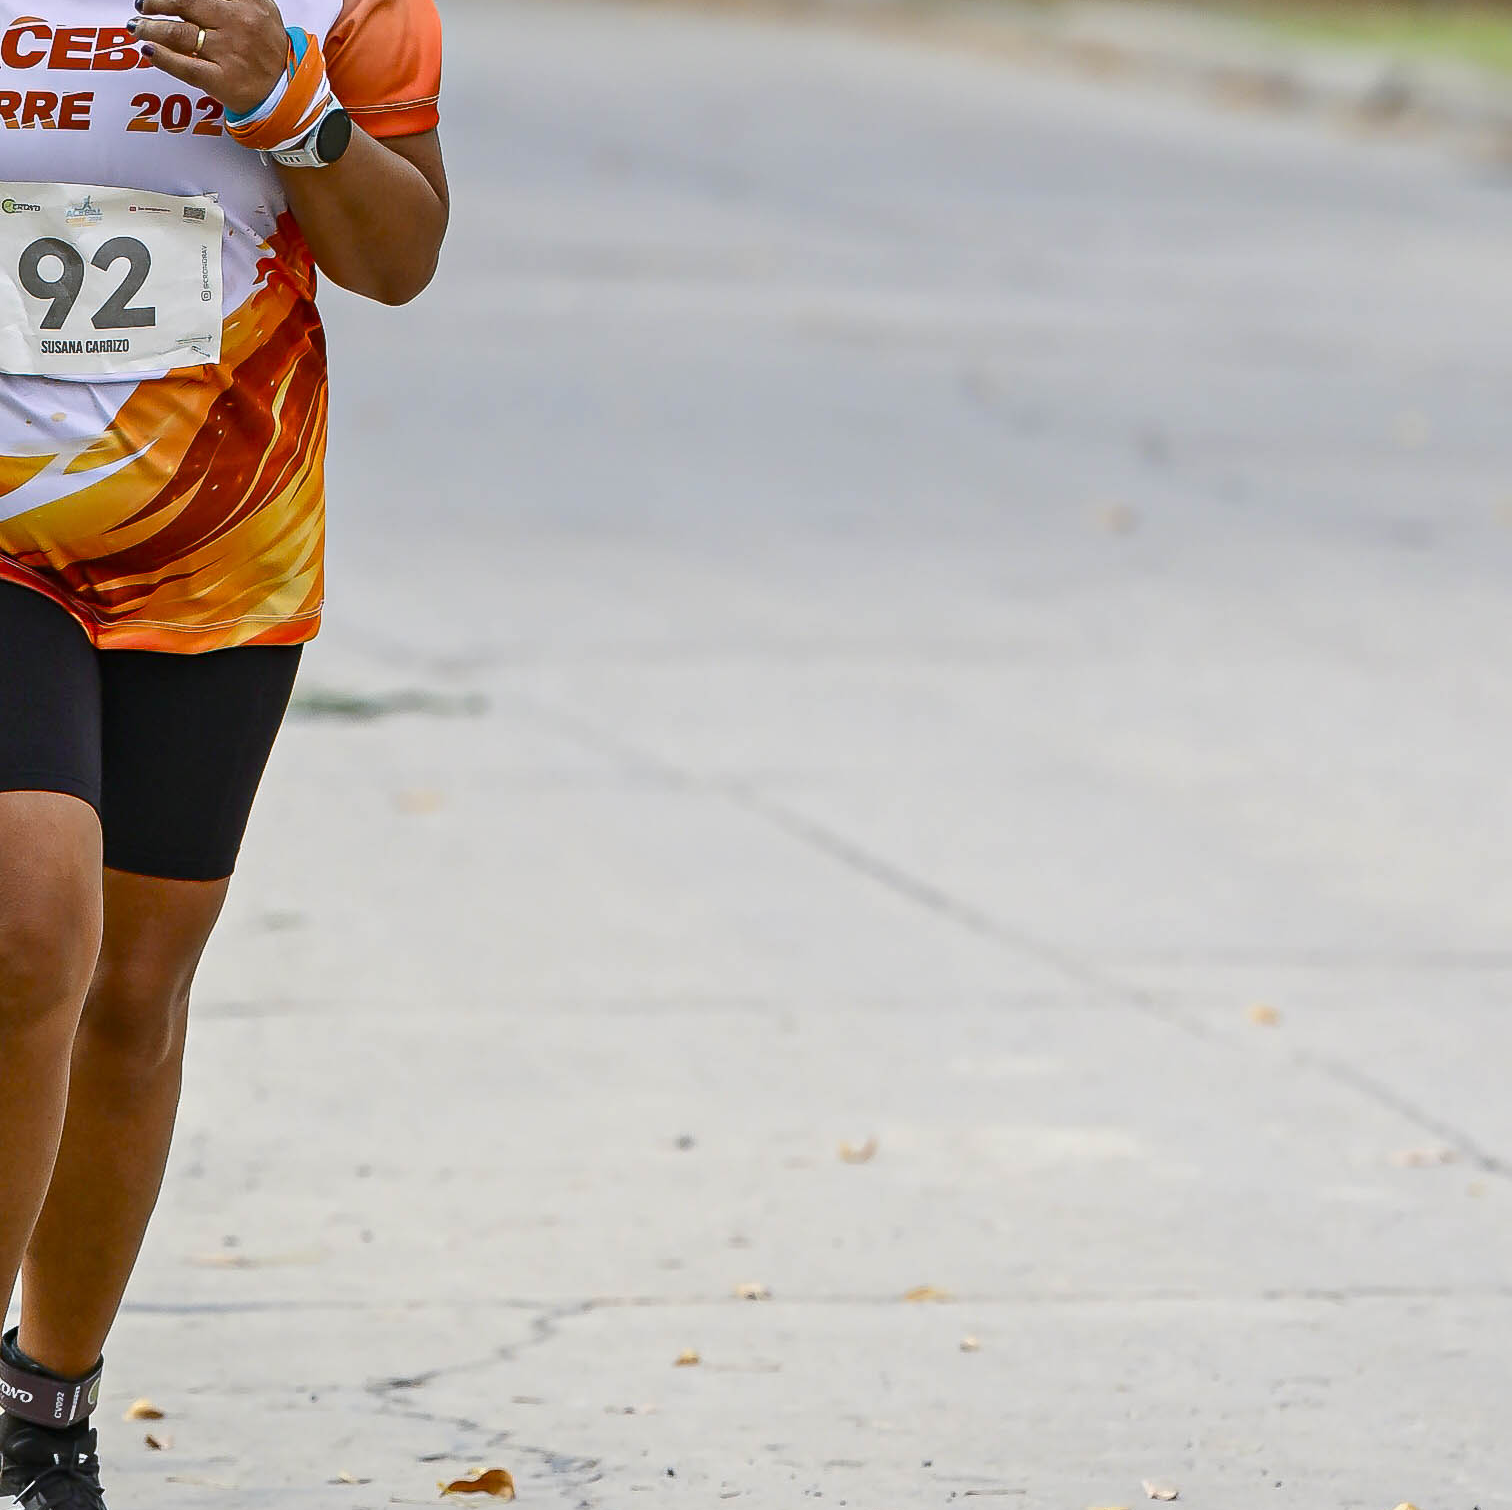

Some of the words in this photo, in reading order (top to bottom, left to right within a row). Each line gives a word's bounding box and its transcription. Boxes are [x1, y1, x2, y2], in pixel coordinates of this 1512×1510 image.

[18, 236, 156, 330] 92
[41, 340, 83, 354] SUSANA
[85, 338, 130, 353] CARRIZO
